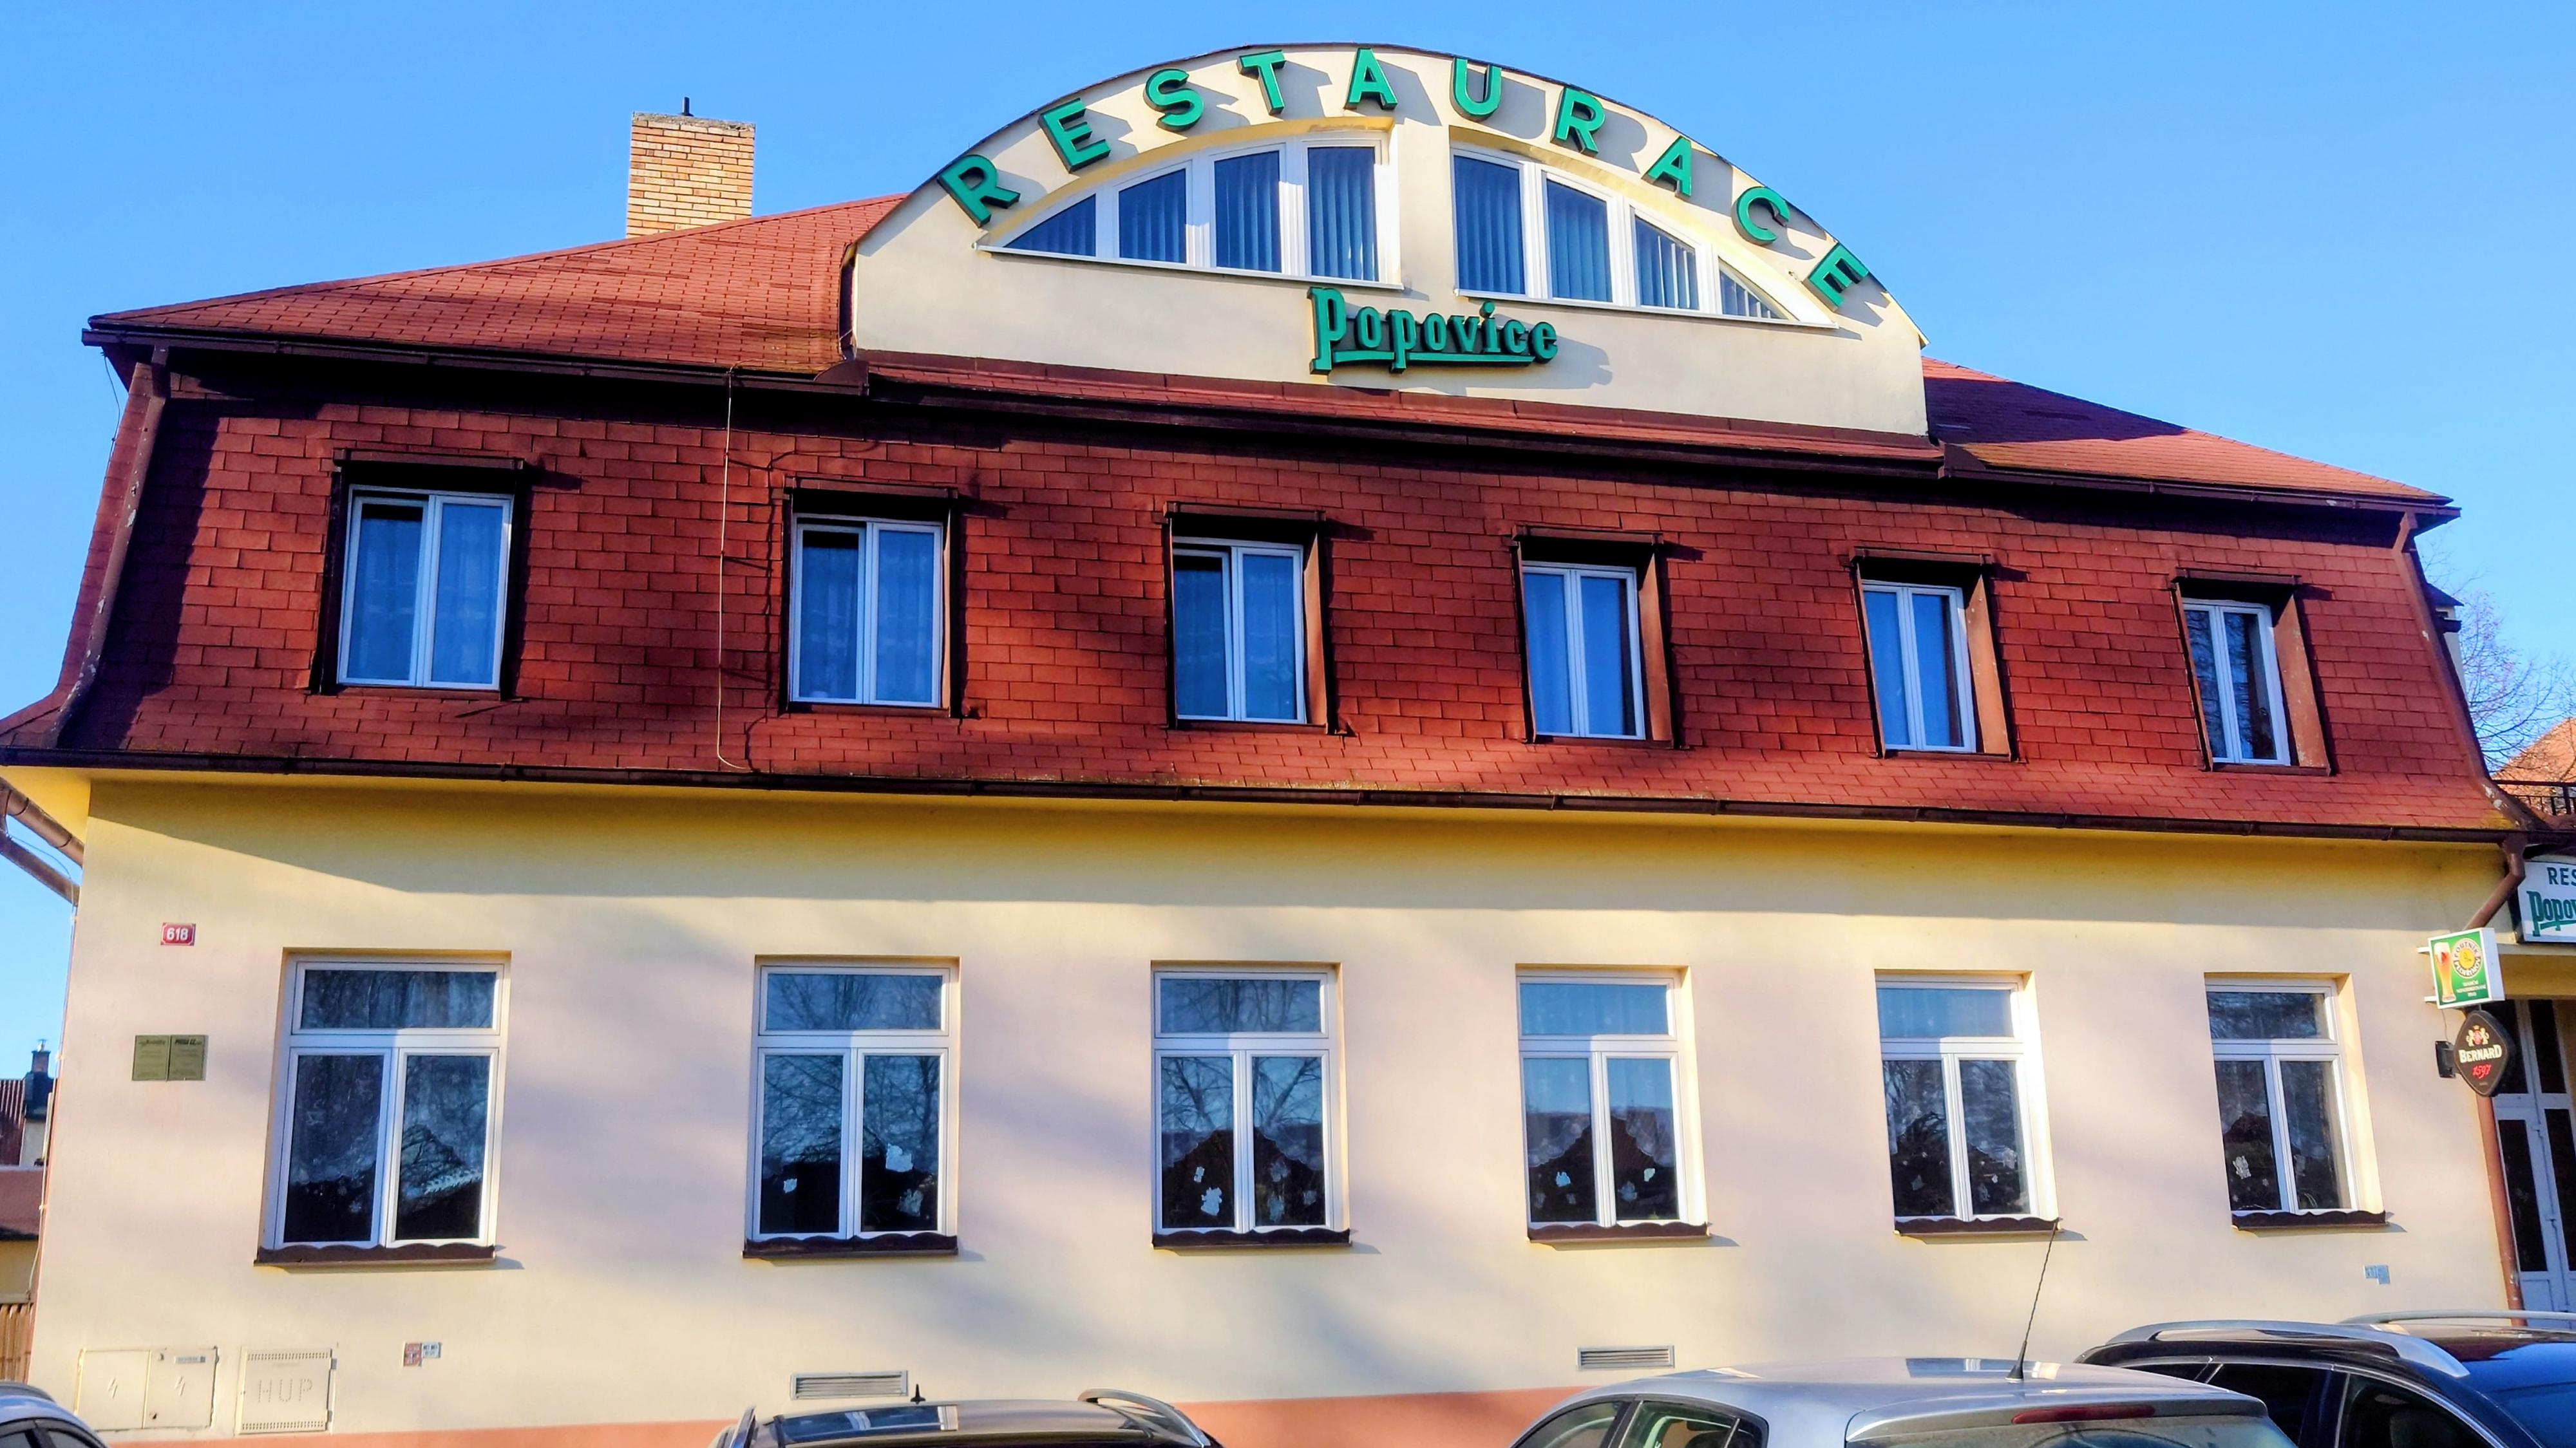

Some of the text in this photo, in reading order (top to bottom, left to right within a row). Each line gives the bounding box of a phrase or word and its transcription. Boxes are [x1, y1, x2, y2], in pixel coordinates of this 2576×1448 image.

[937, 48, 1869, 310] RESTAURACE
[1307, 287, 1558, 375] Popovice
[166, 927, 189, 941] 618
[2458, 1044, 2503, 1063] BERNARD
[2472, 1064, 2492, 1079] 1597
[258, 1378, 313, 1402] HUP
